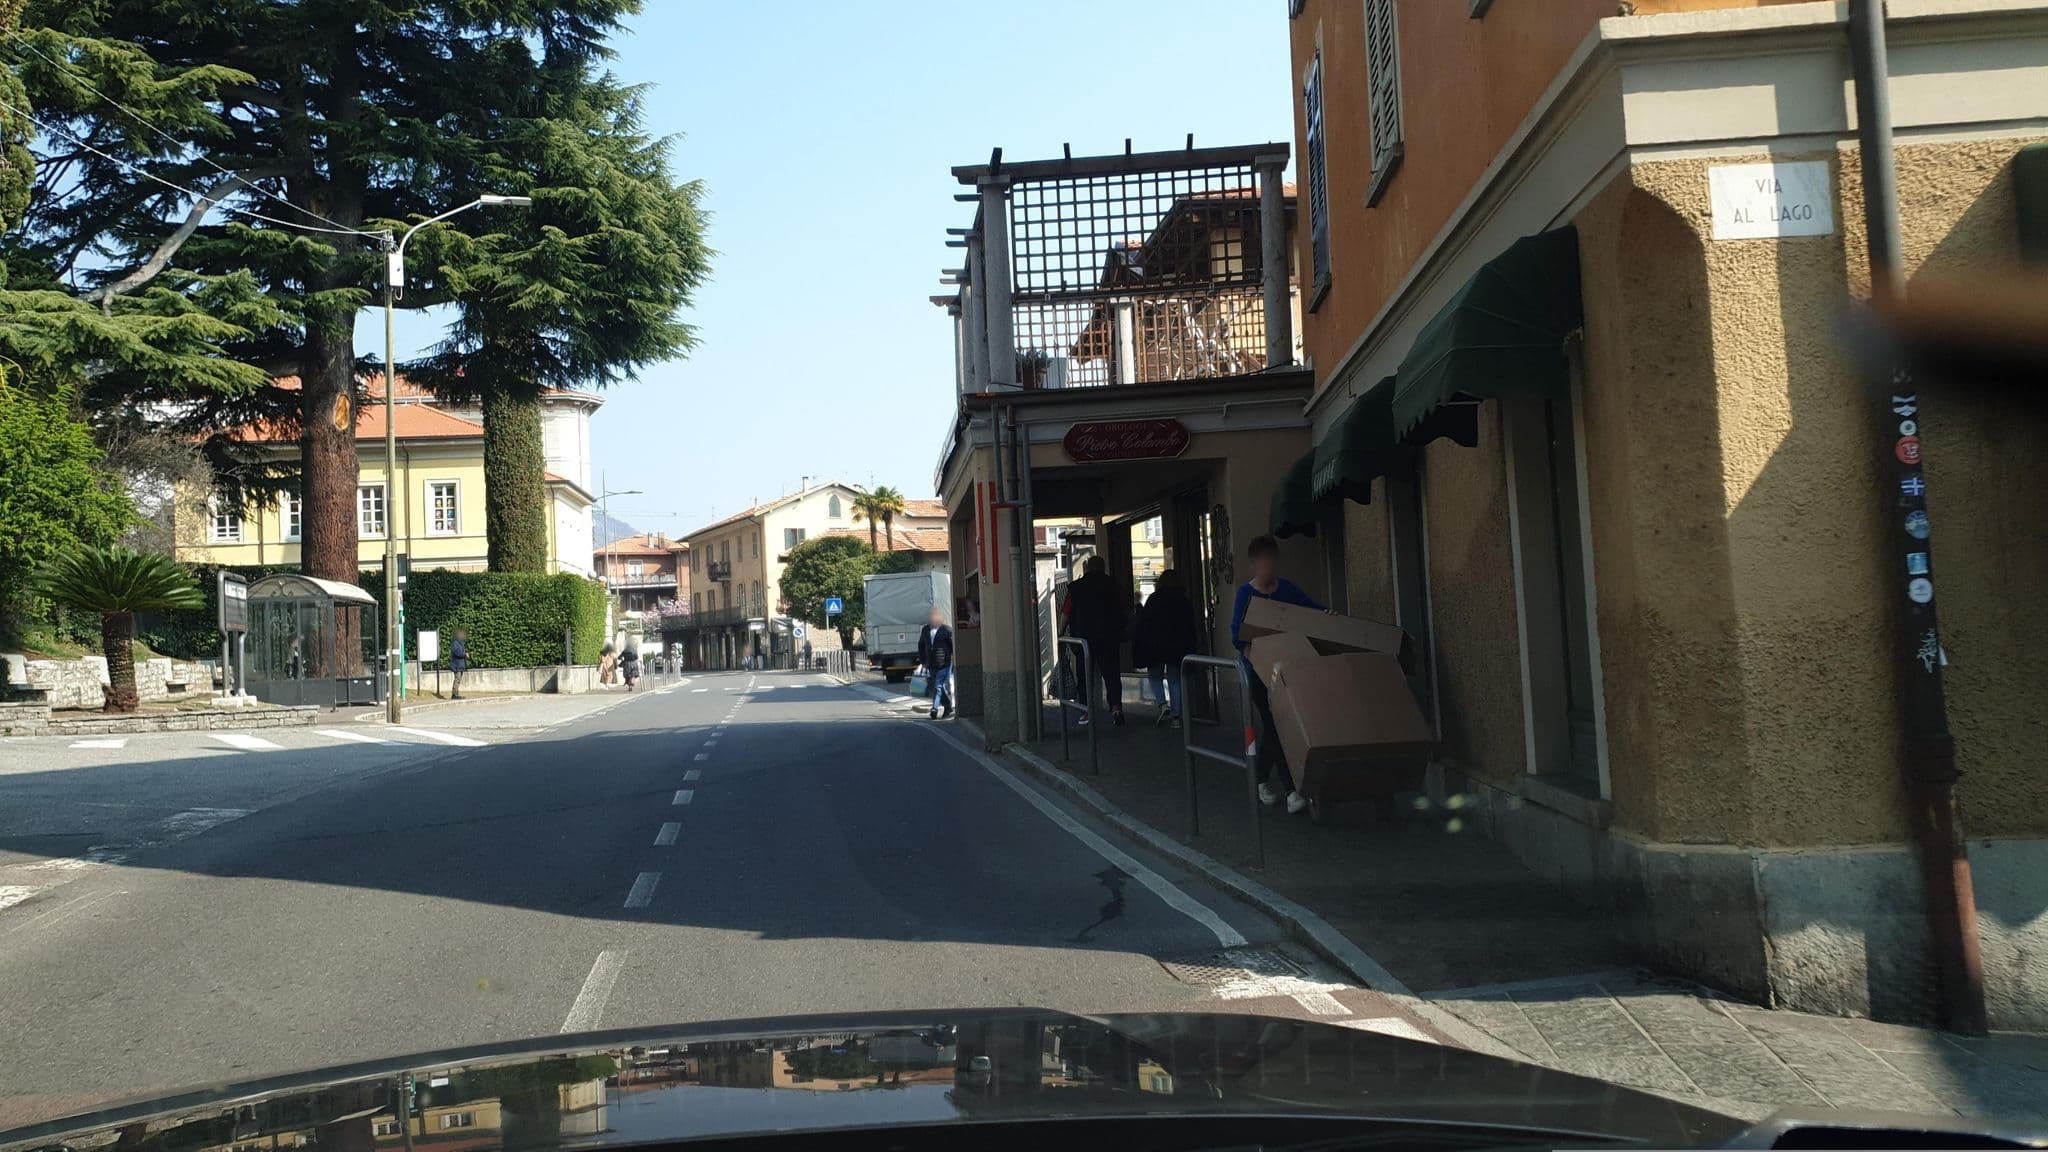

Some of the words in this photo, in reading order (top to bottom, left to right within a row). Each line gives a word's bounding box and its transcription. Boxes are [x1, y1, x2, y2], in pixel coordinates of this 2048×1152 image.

[1755, 178, 1783, 194] VIA
[1733, 207, 1754, 224] AL
[1770, 204, 1813, 222] LAGO
